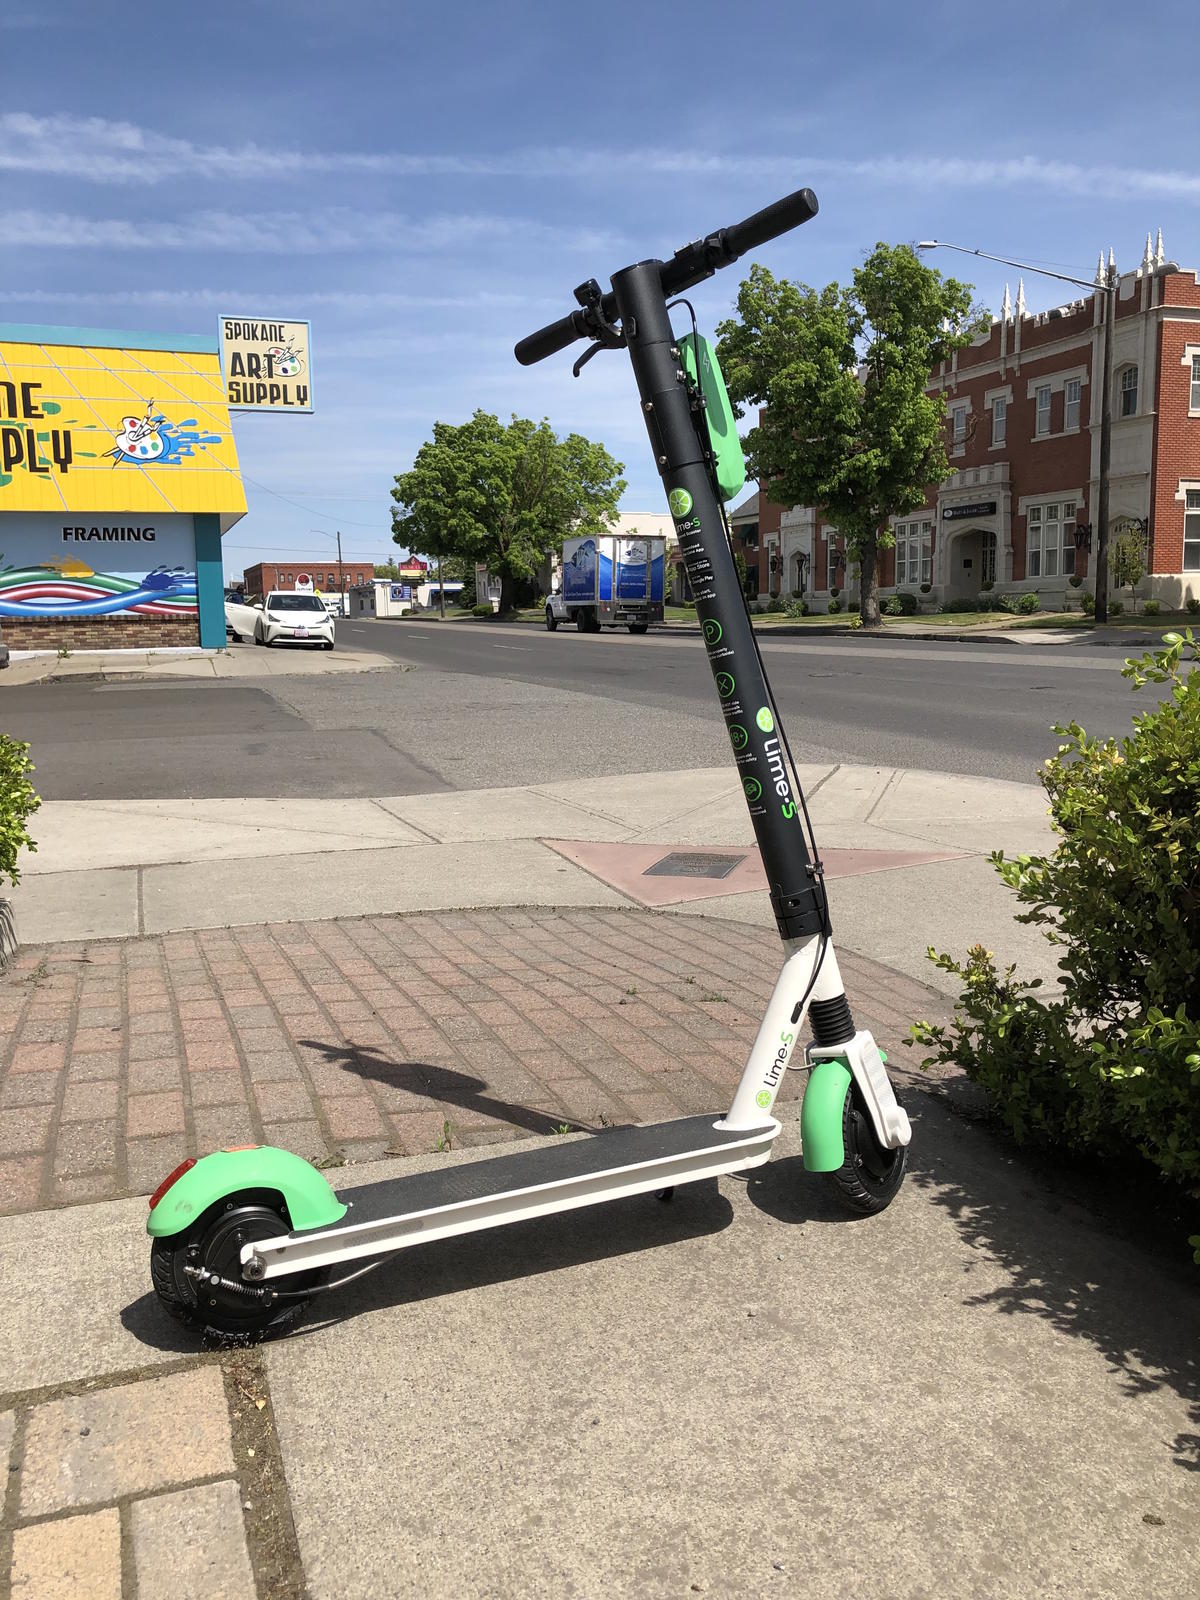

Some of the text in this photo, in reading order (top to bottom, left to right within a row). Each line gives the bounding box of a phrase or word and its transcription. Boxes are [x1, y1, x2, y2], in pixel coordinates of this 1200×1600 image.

[225, 321, 286, 343] SPOKANE
[230, 351, 277, 380] ART
[228, 381, 308, 406] SUPPLY
[62, 527, 156, 542] FRAMING
